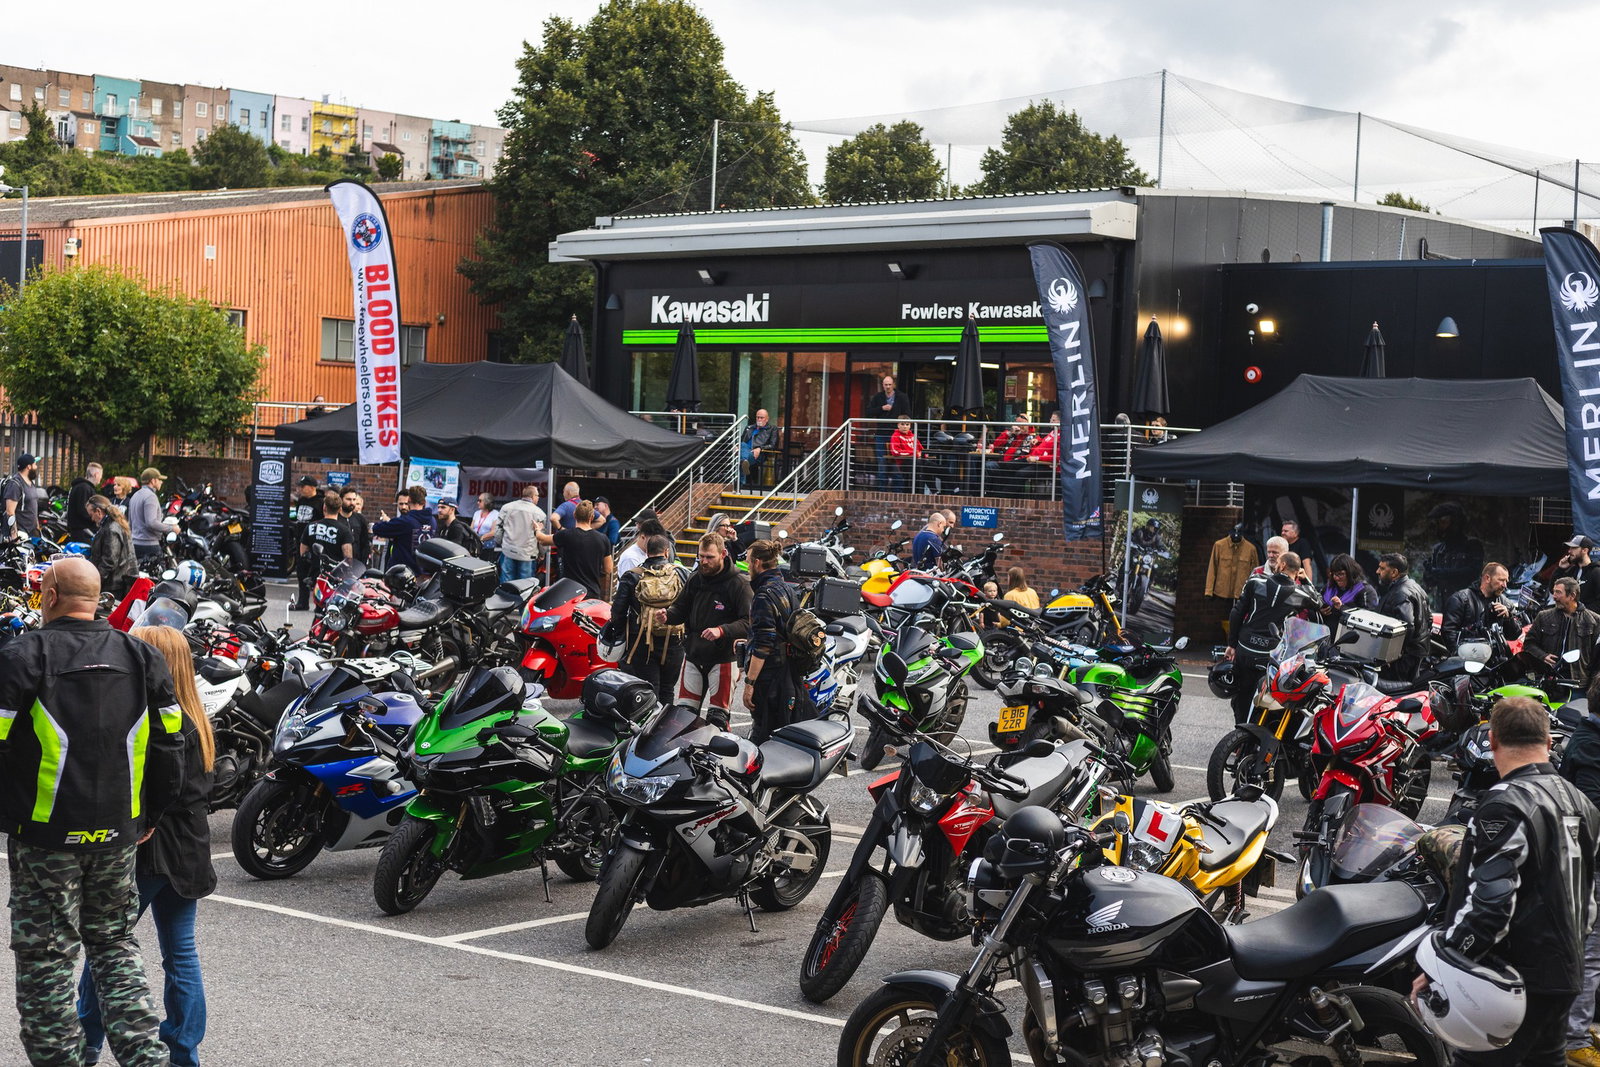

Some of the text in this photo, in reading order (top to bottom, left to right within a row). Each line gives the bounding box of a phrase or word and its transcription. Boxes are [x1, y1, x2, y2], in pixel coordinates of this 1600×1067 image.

[365, 264, 396, 355] BLOOD
[651, 292, 770, 323] Kawasaki
[902, 300, 1043, 320] Fowlers Kawasak
[374, 365, 399, 447] BIKES
[1059, 320, 1092, 479] MERLIN
[469, 479, 509, 497] BLOOD
[963, 507, 996, 515] MOTORCYCLE
[308, 523, 339, 540] EBC
[1002, 719, 1022, 730] ZZR
[1146, 810, 1169, 842] L
[1087, 922, 1130, 935] HONDA
